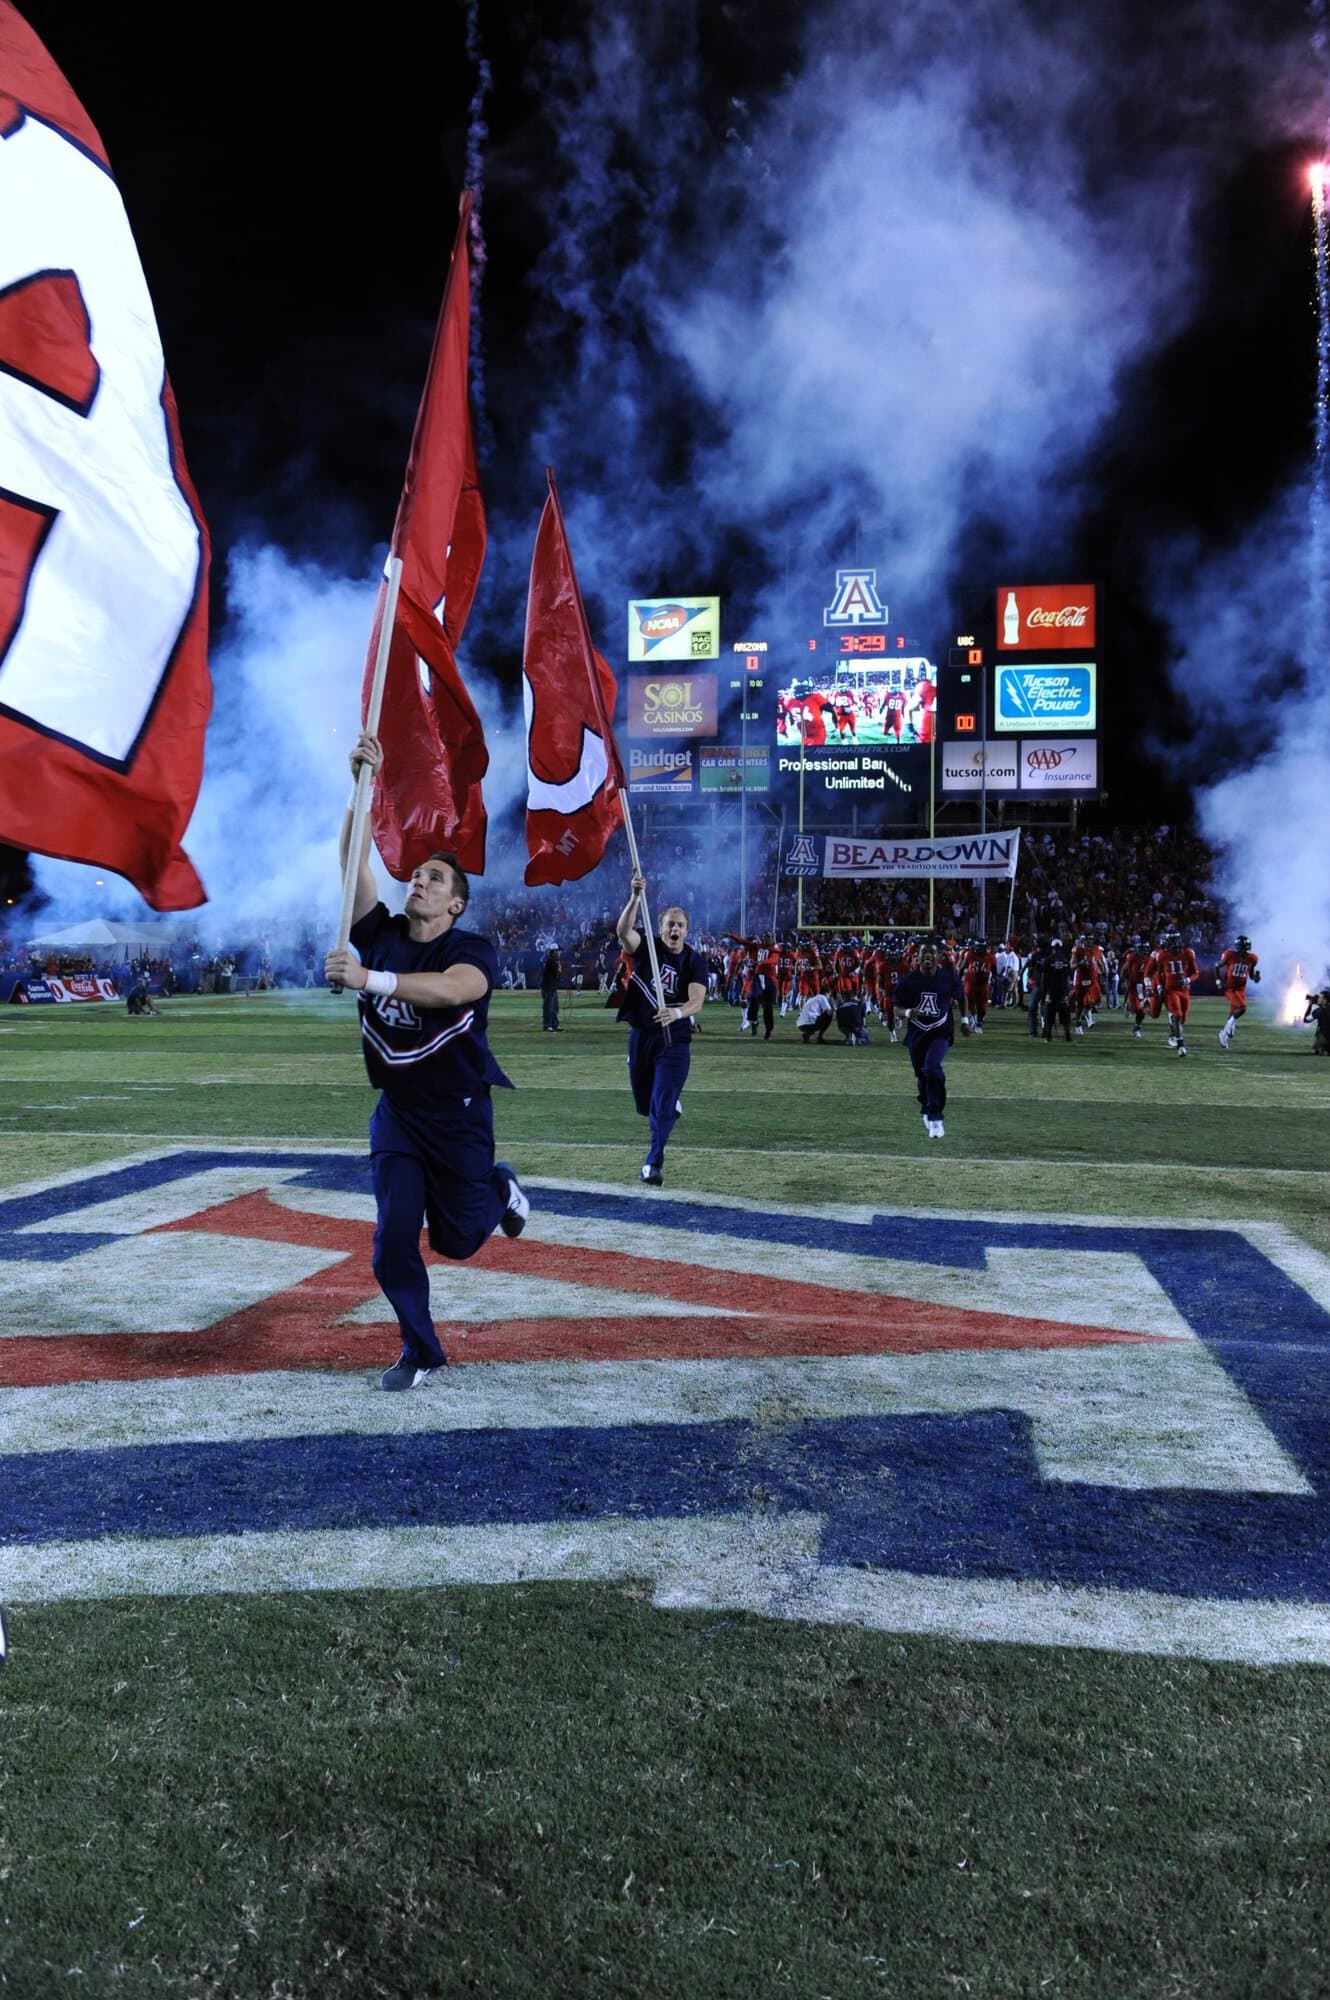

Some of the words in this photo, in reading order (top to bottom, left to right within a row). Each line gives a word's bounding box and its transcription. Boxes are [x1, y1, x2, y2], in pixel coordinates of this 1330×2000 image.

[823, 568, 888, 626] A
[647, 617, 680, 631] NCAA
[1026, 605, 1089, 628] Coca-Cola
[733, 642, 768, 653] ARIZONA
[808, 640, 816, 651] 3
[896, 637, 904, 648] 3
[746, 656, 759, 671] 0
[968, 649, 982, 664] 0
[1022, 673, 1070, 688] Tucson
[644, 682, 702, 711] SOL
[1027, 686, 1082, 699] Electric
[1033, 698, 1082, 711] Power
[643, 711, 703, 724] CASINOS
[630, 748, 692, 771] Budget
[701, 759, 716, 767] CAR
[737, 758, 768, 767] CNTERS
[779, 758, 858, 772] Professional
[1029, 748, 1059, 770] AAA
[825, 777, 885, 789] Unlimited
[1044, 773, 1092, 782] Insurance
[785, 834, 819, 866] A
[831, 838, 1012, 865] BEARDOWN
[1168, 960, 1185, 975] 11
[916, 992, 941, 1018] A
